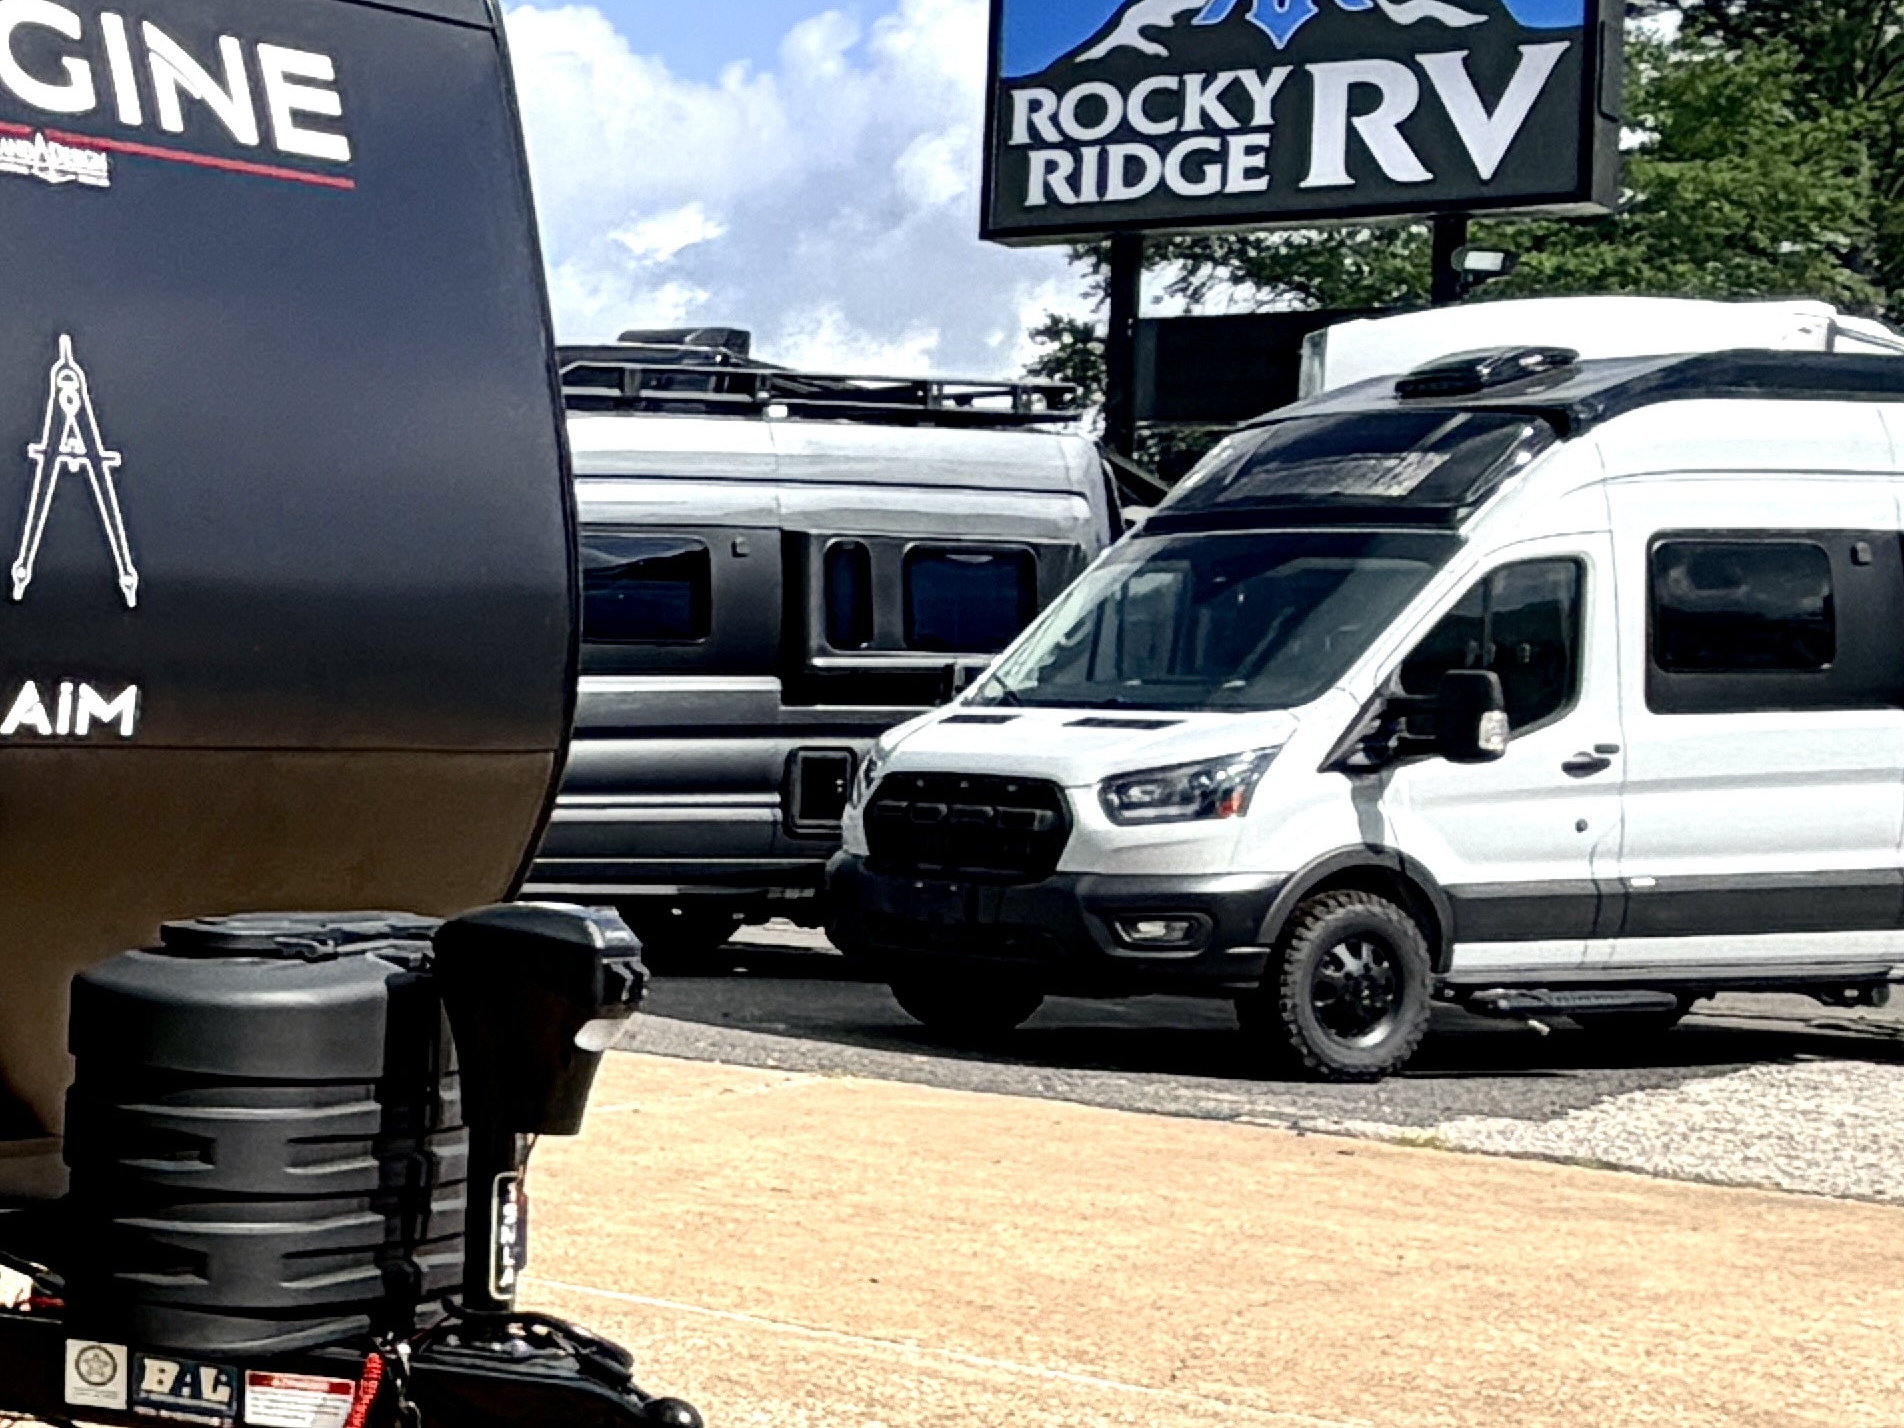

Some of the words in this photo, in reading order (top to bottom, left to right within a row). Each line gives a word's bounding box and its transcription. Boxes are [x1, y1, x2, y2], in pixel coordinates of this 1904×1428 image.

[1008, 66, 1294, 146] ROCKY
[1298, 40, 1572, 189] RV
[1024, 134, 1273, 208] RIDGE
